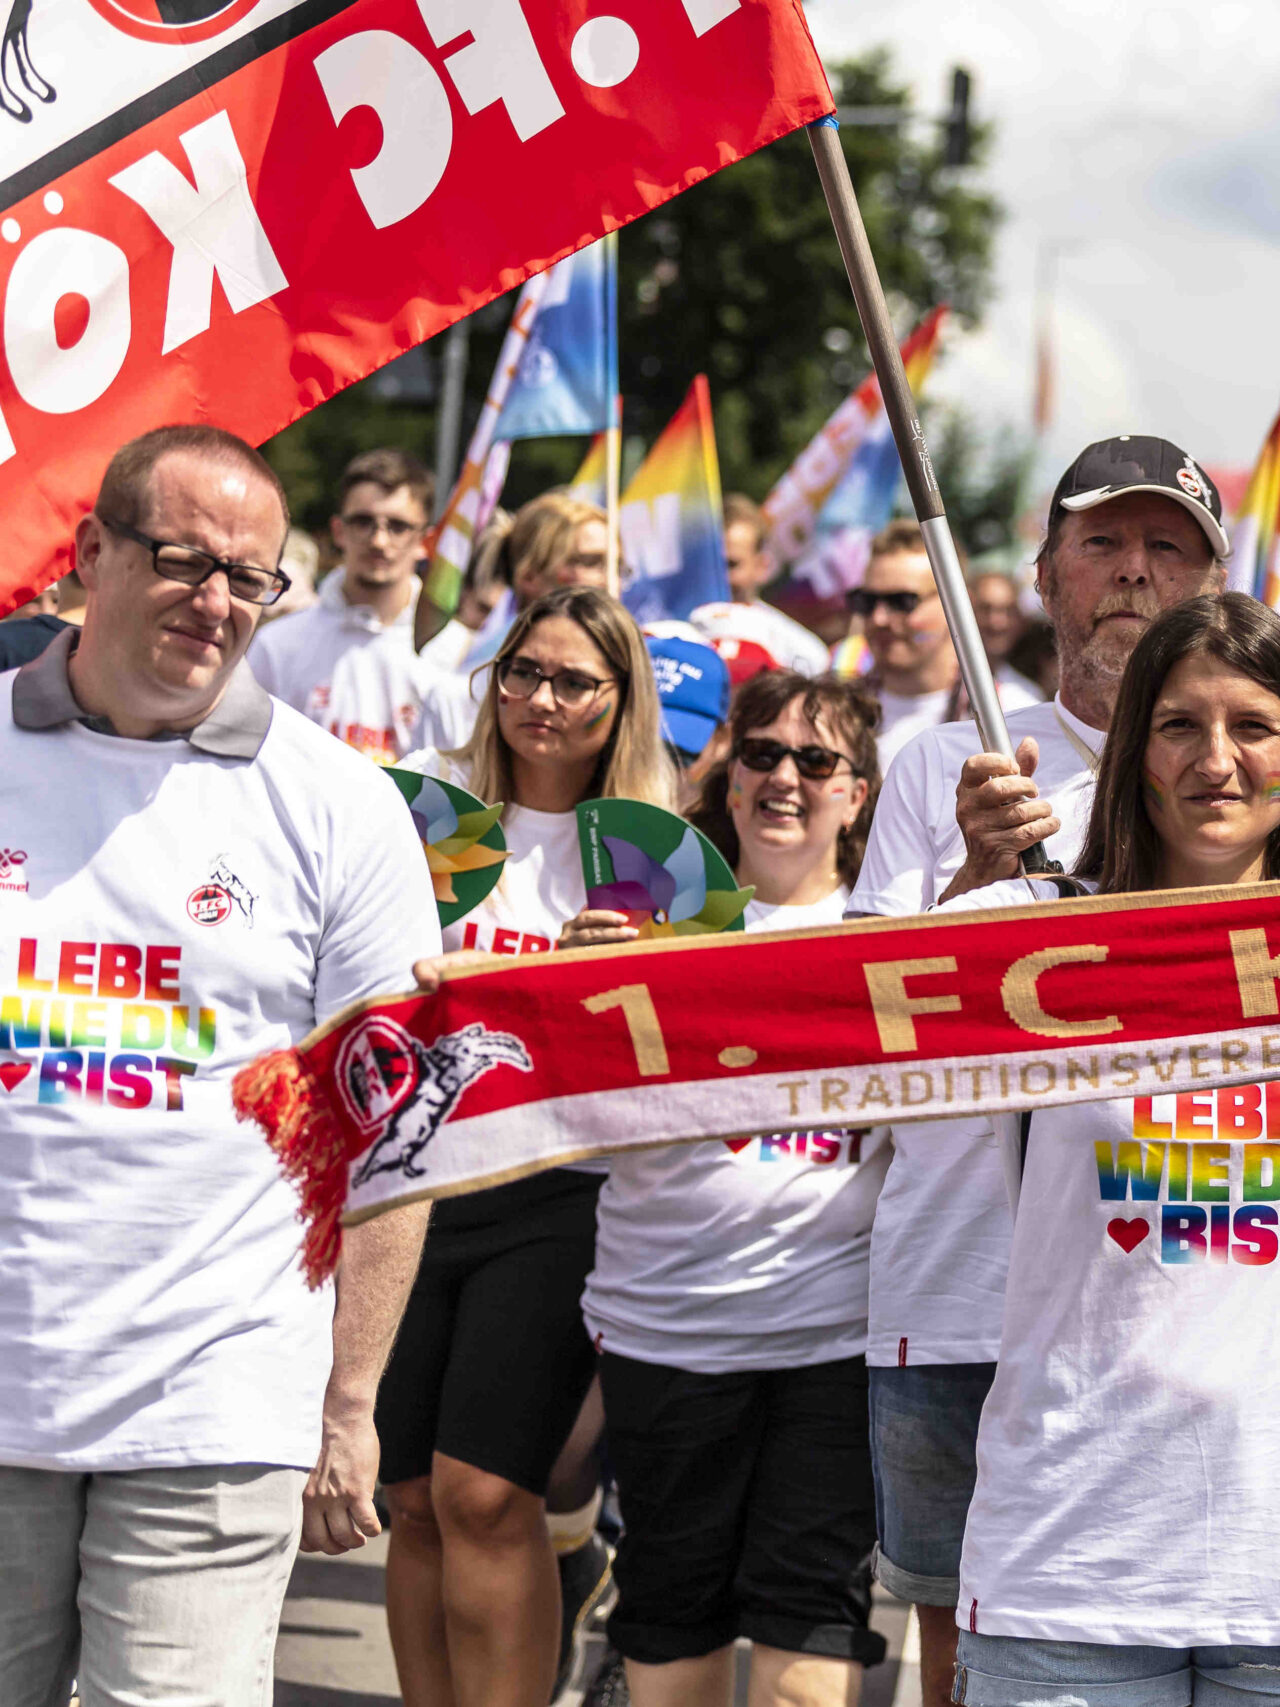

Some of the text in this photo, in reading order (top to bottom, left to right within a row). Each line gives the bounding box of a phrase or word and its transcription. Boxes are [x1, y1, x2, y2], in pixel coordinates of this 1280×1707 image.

[17, 937, 183, 1003] LEBE
[119, 1003, 217, 1060] DU
[579, 983, 758, 1077] 1.
[862, 944, 1124, 1054] FC
[37, 1049, 199, 1113] BIST
[758, 1128, 873, 1165] BIST
[1093, 1140, 1232, 1203] WIE
